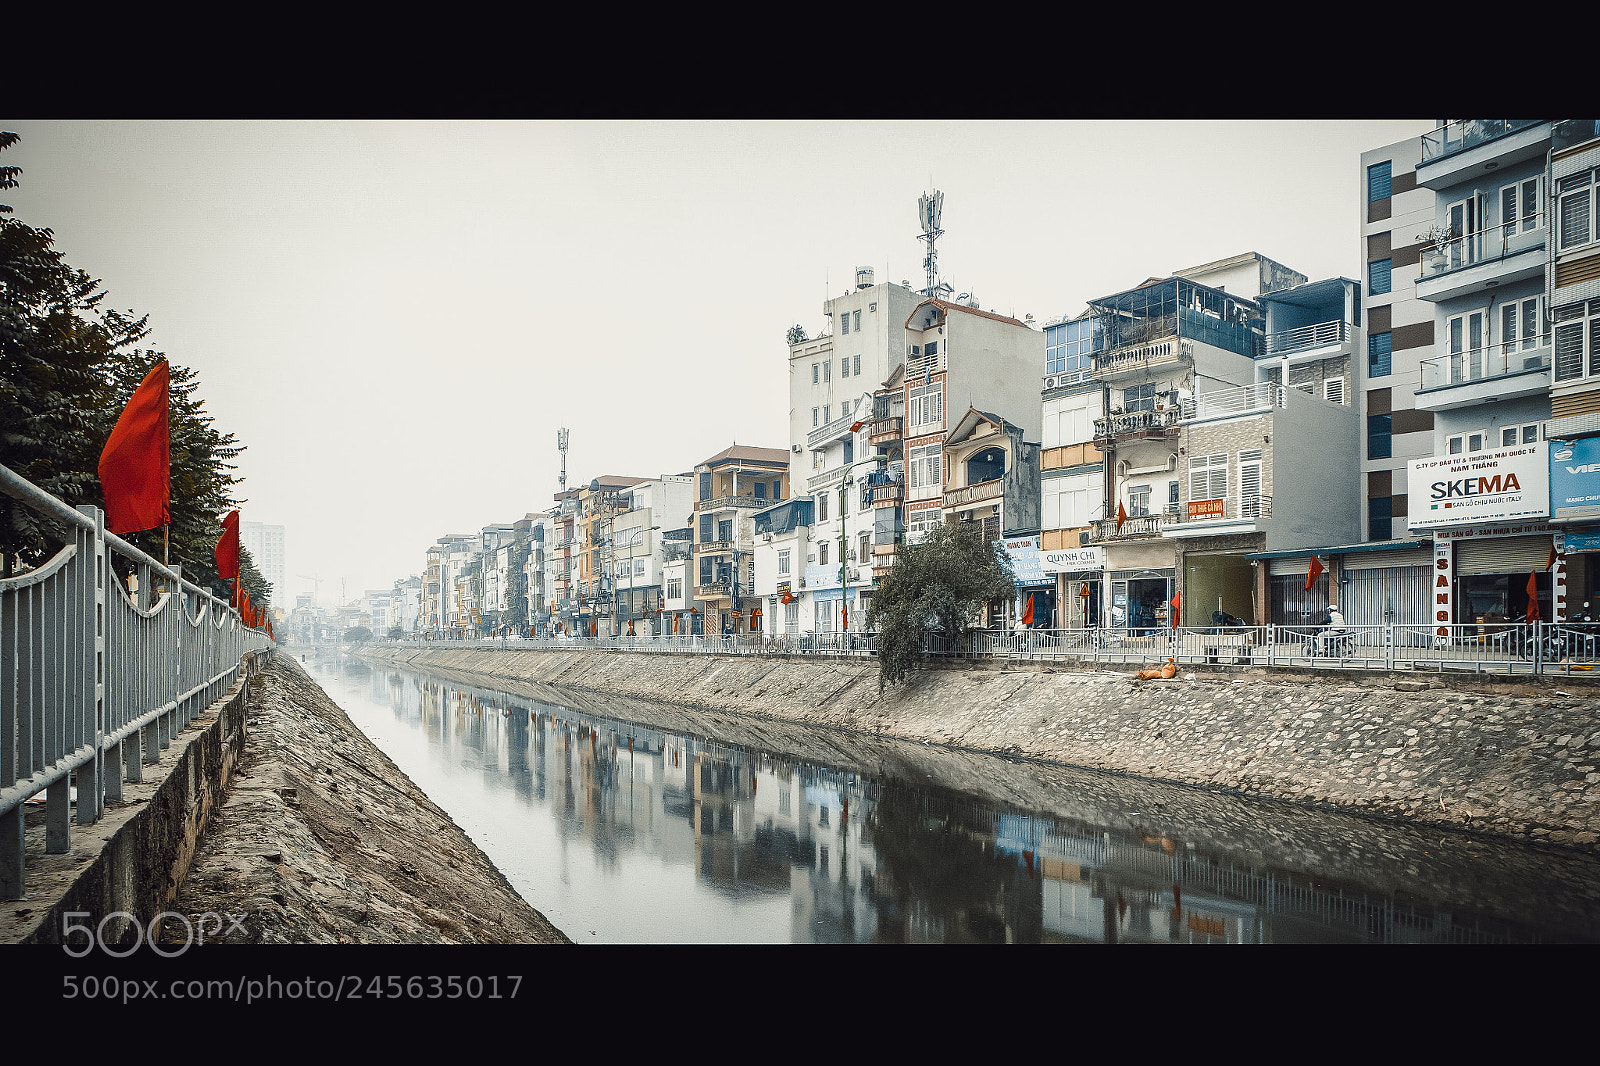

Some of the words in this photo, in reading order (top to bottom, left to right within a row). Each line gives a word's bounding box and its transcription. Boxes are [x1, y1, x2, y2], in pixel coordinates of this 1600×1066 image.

[1451, 465, 1470, 473] NAM
[1430, 473, 1521, 499] SKEMA
[1080, 551, 1095, 560] CHI
